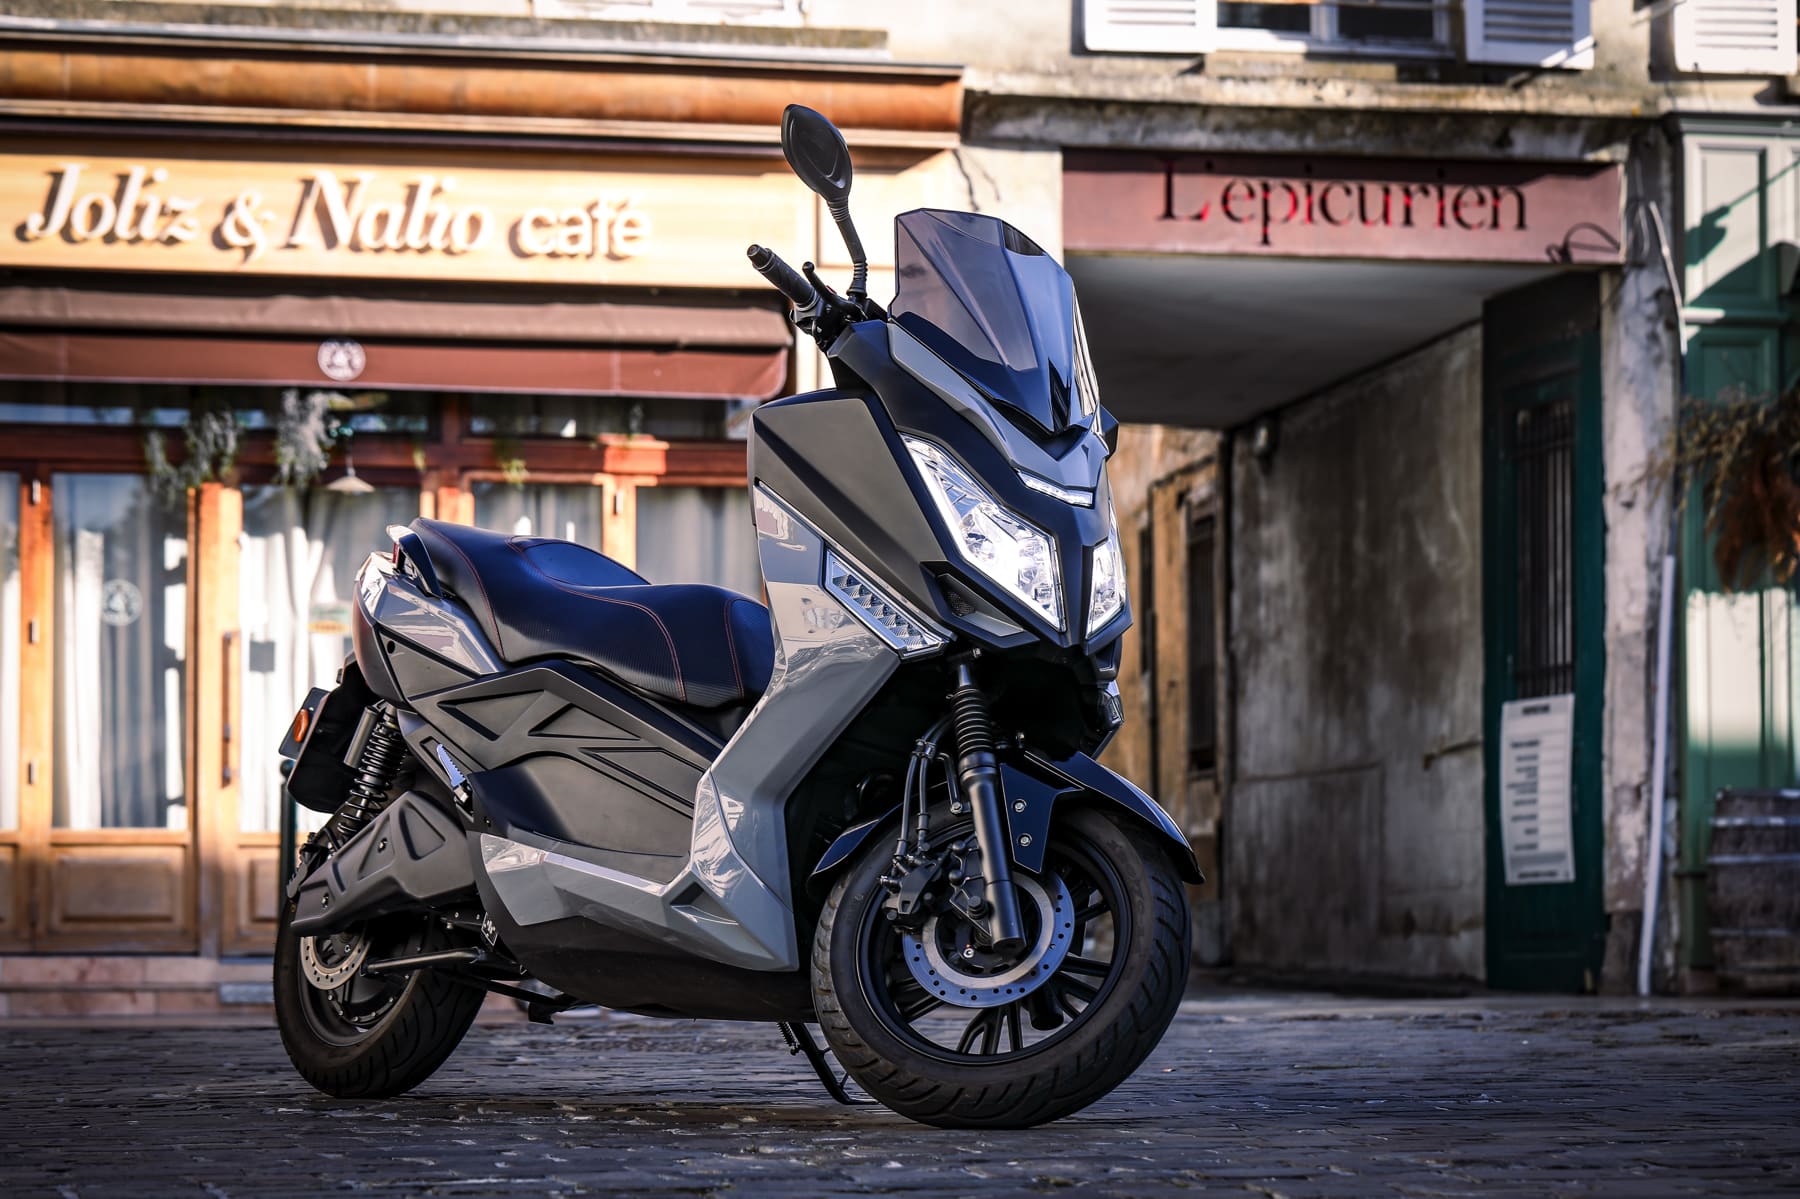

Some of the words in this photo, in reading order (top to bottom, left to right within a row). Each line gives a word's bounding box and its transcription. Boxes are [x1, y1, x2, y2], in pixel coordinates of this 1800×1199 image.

[24, 163, 199, 242] Joliz
[217, 188, 276, 262] &
[286, 170, 494, 251] Nalio
[516, 193, 651, 256] café
